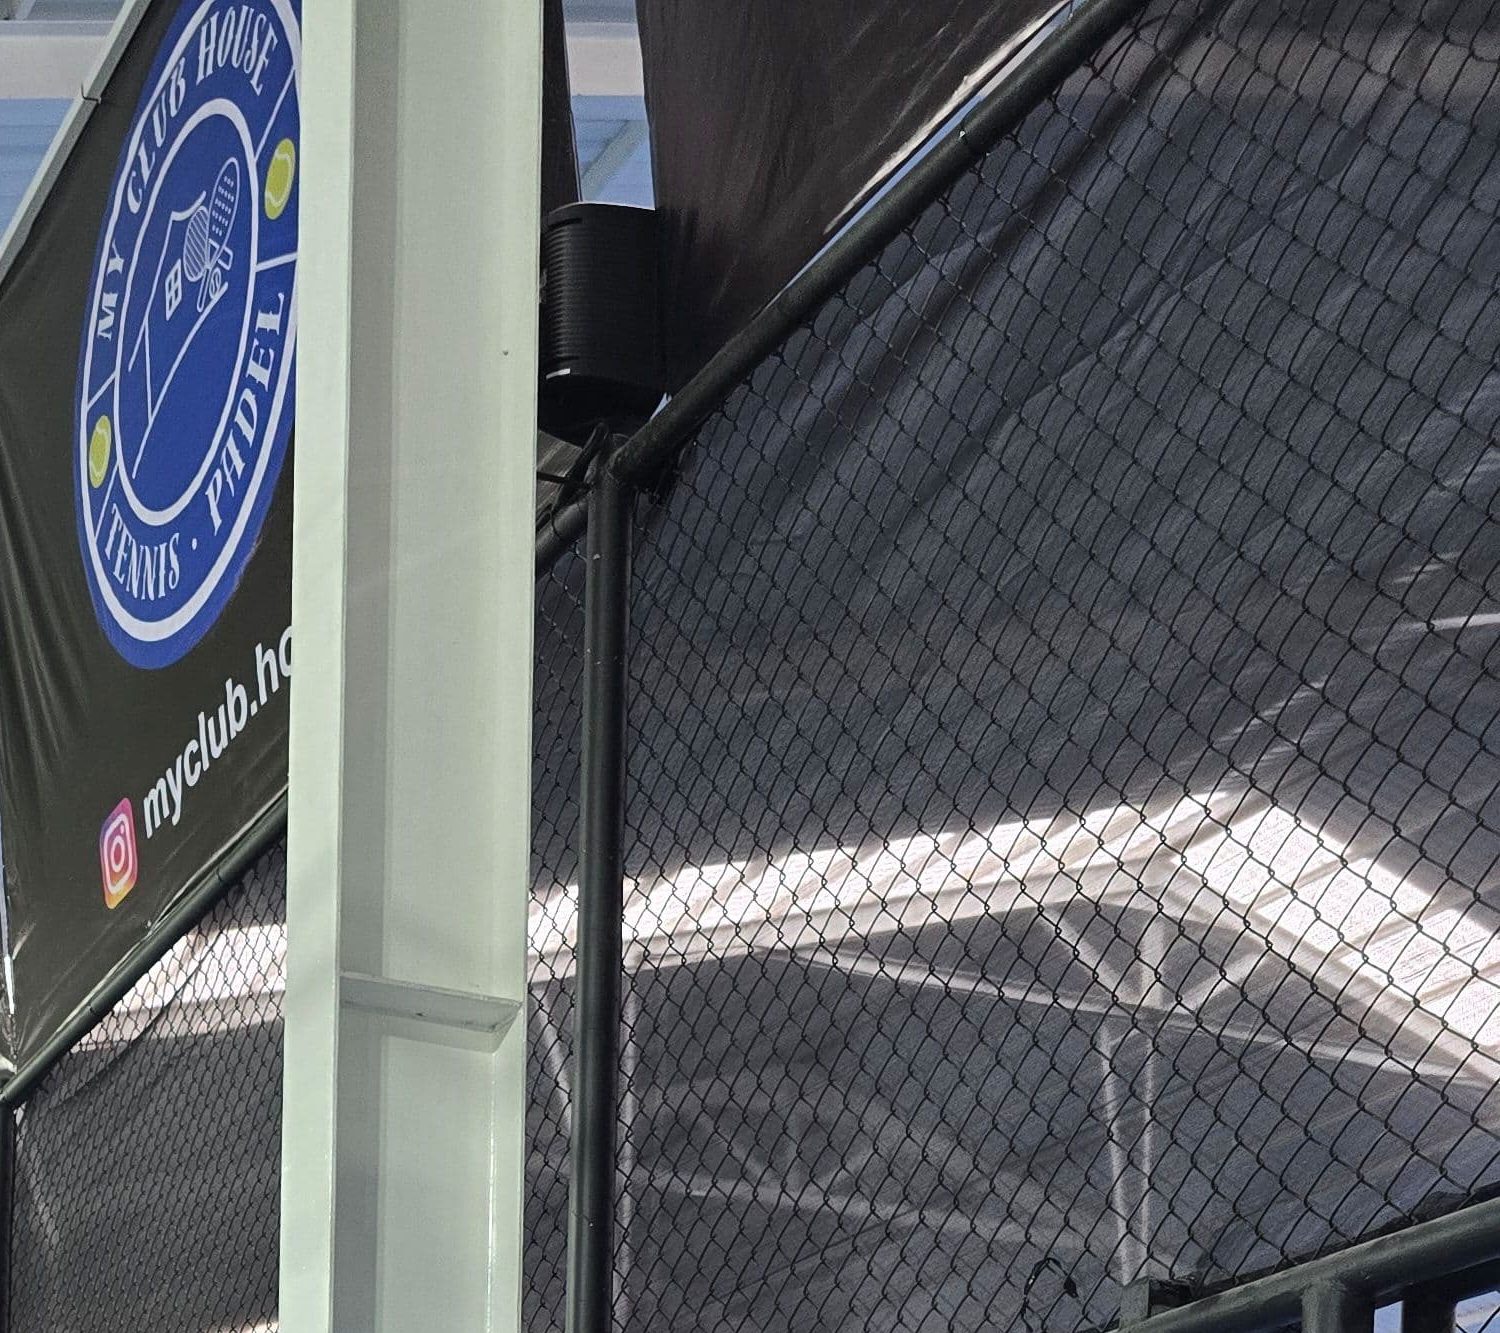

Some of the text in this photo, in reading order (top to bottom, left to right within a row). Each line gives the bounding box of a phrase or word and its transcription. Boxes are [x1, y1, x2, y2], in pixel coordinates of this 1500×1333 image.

[97, 5, 278, 340] MY CLUB HOUSE
[104, 292, 285, 601] TENNIS PADEL
[142, 625, 292, 839] myclub.ho
